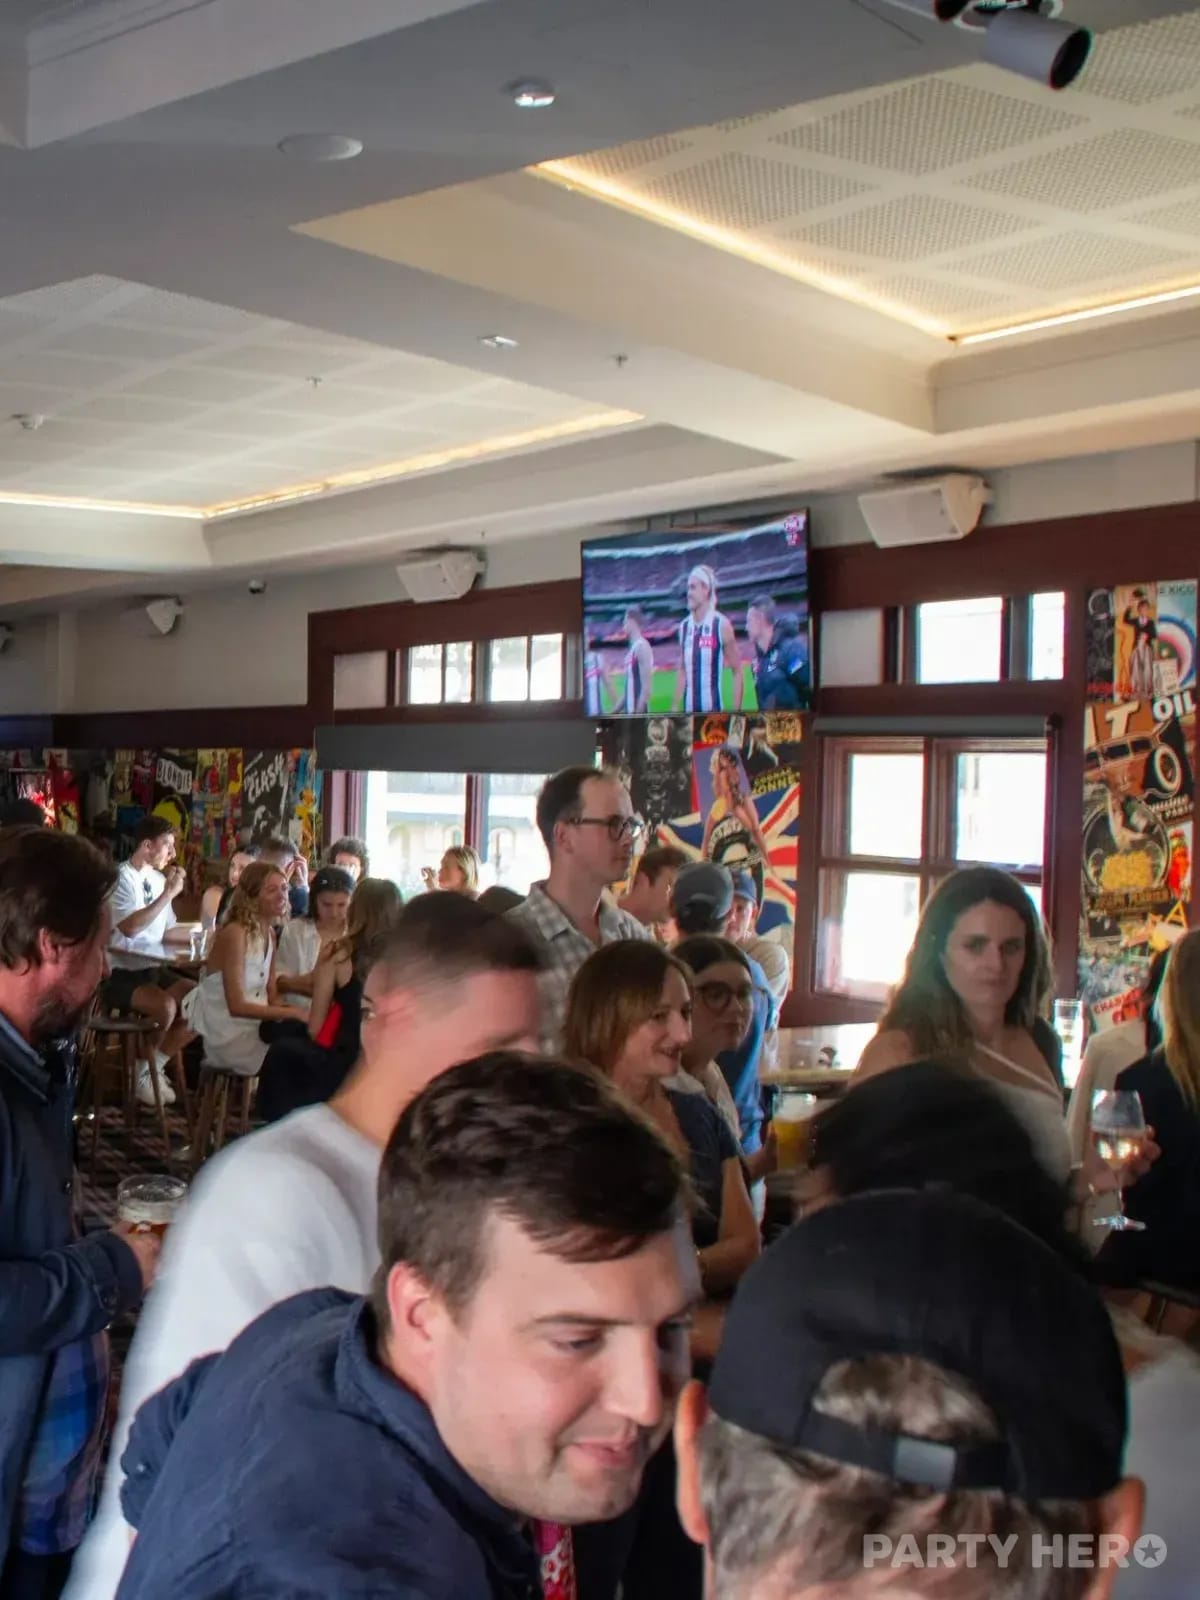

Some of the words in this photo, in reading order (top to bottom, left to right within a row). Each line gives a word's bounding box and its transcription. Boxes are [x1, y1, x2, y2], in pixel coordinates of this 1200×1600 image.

[1153, 691, 1197, 722] OIL
[156, 758, 193, 794] BLONDIE
[247, 752, 286, 804] CLASH
